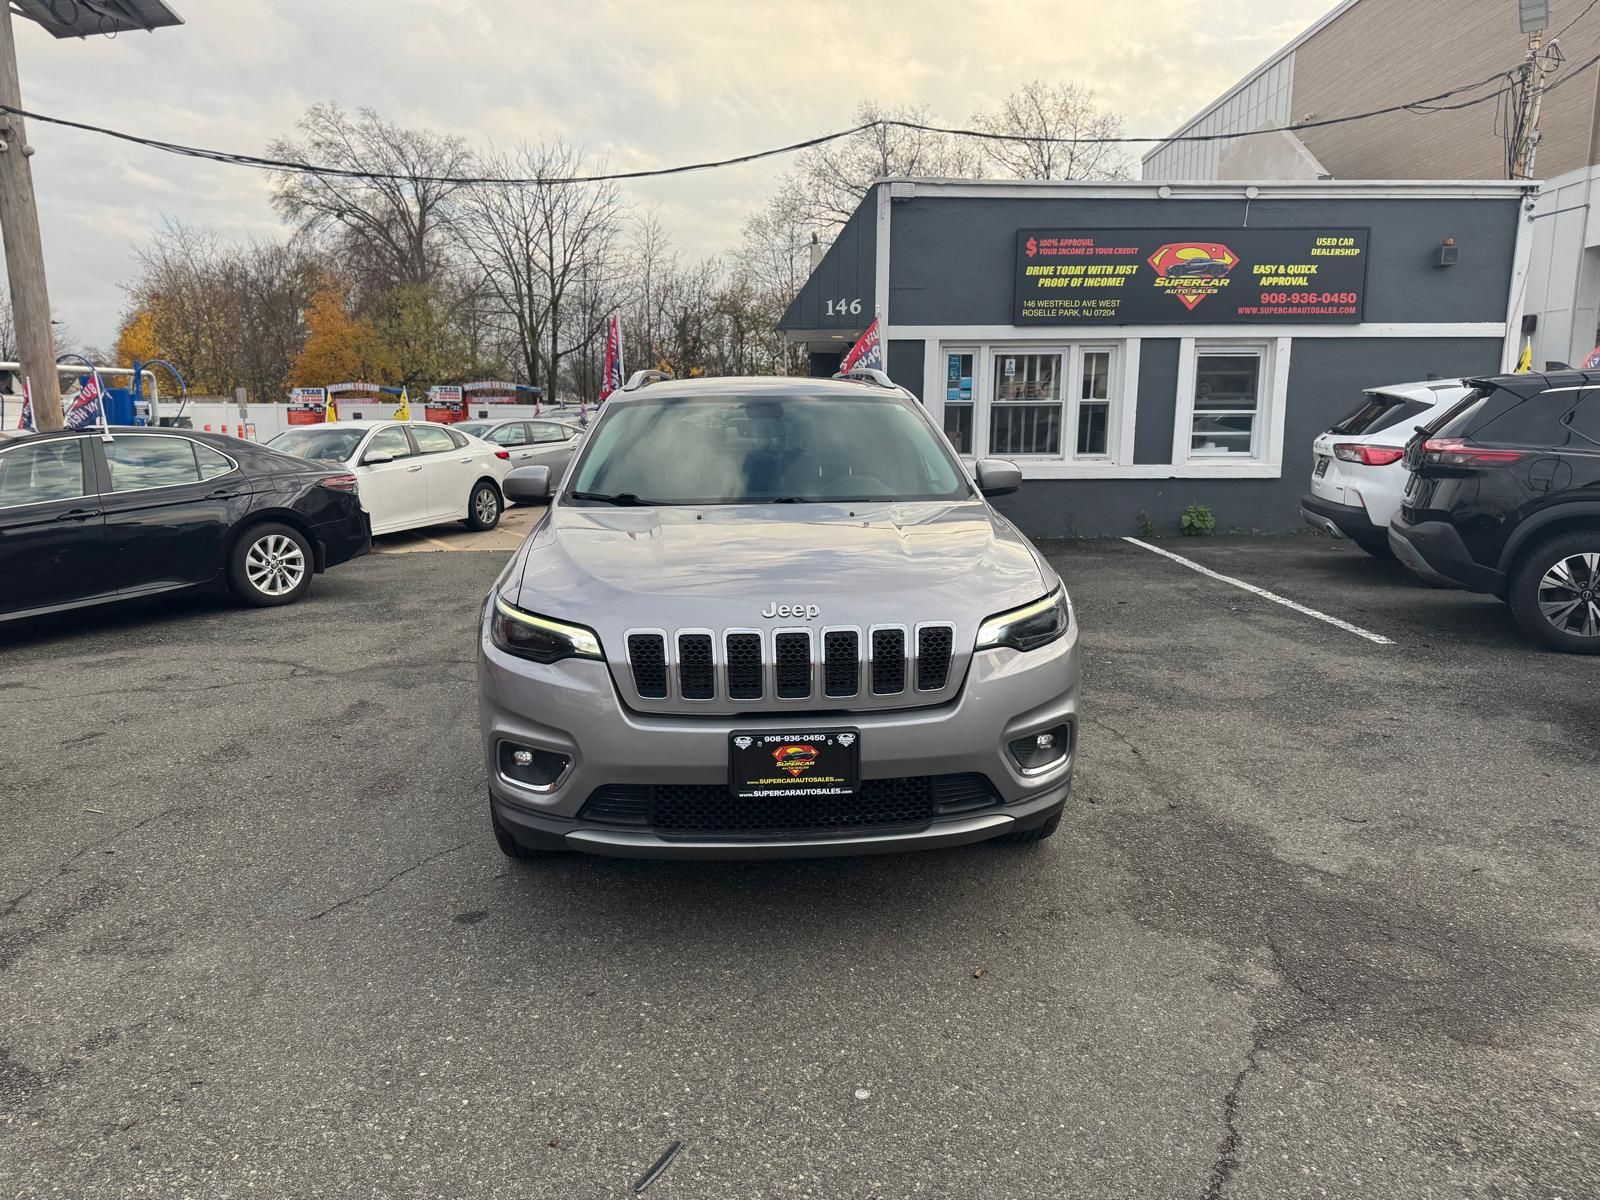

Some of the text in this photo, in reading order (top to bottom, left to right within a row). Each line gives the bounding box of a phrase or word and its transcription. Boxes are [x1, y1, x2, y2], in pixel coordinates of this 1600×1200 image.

[1039, 239, 1094, 247] 100% APPROVAL
[1316, 237, 1354, 246] USED CAR
[1113, 247, 1139, 255] CREDIT
[1311, 248, 1360, 256] DEALERSHIP
[1025, 265, 1139, 276] DRIVE TODAY WITH JUST
[1253, 265, 1318, 275] EASY & QUICK
[1037, 277, 1125, 288] PROOF OF INCOME!
[1153, 277, 1231, 287] SUPERCAR
[1259, 277, 1309, 286] APPROVAL
[1260, 292, 1357, 304] 908-936-0450
[826, 298, 862, 316] 146
[1237, 306, 1356, 315] WWW.SUPERCARAUTOSALES.COM
[1022, 309, 1057, 317] ROSELLE
[1058, 309, 1081, 317] PARK,
[761, 601, 820, 621] Jeep
[739, 788, 852, 797] www.SUPERCARAUTOSALES.com
